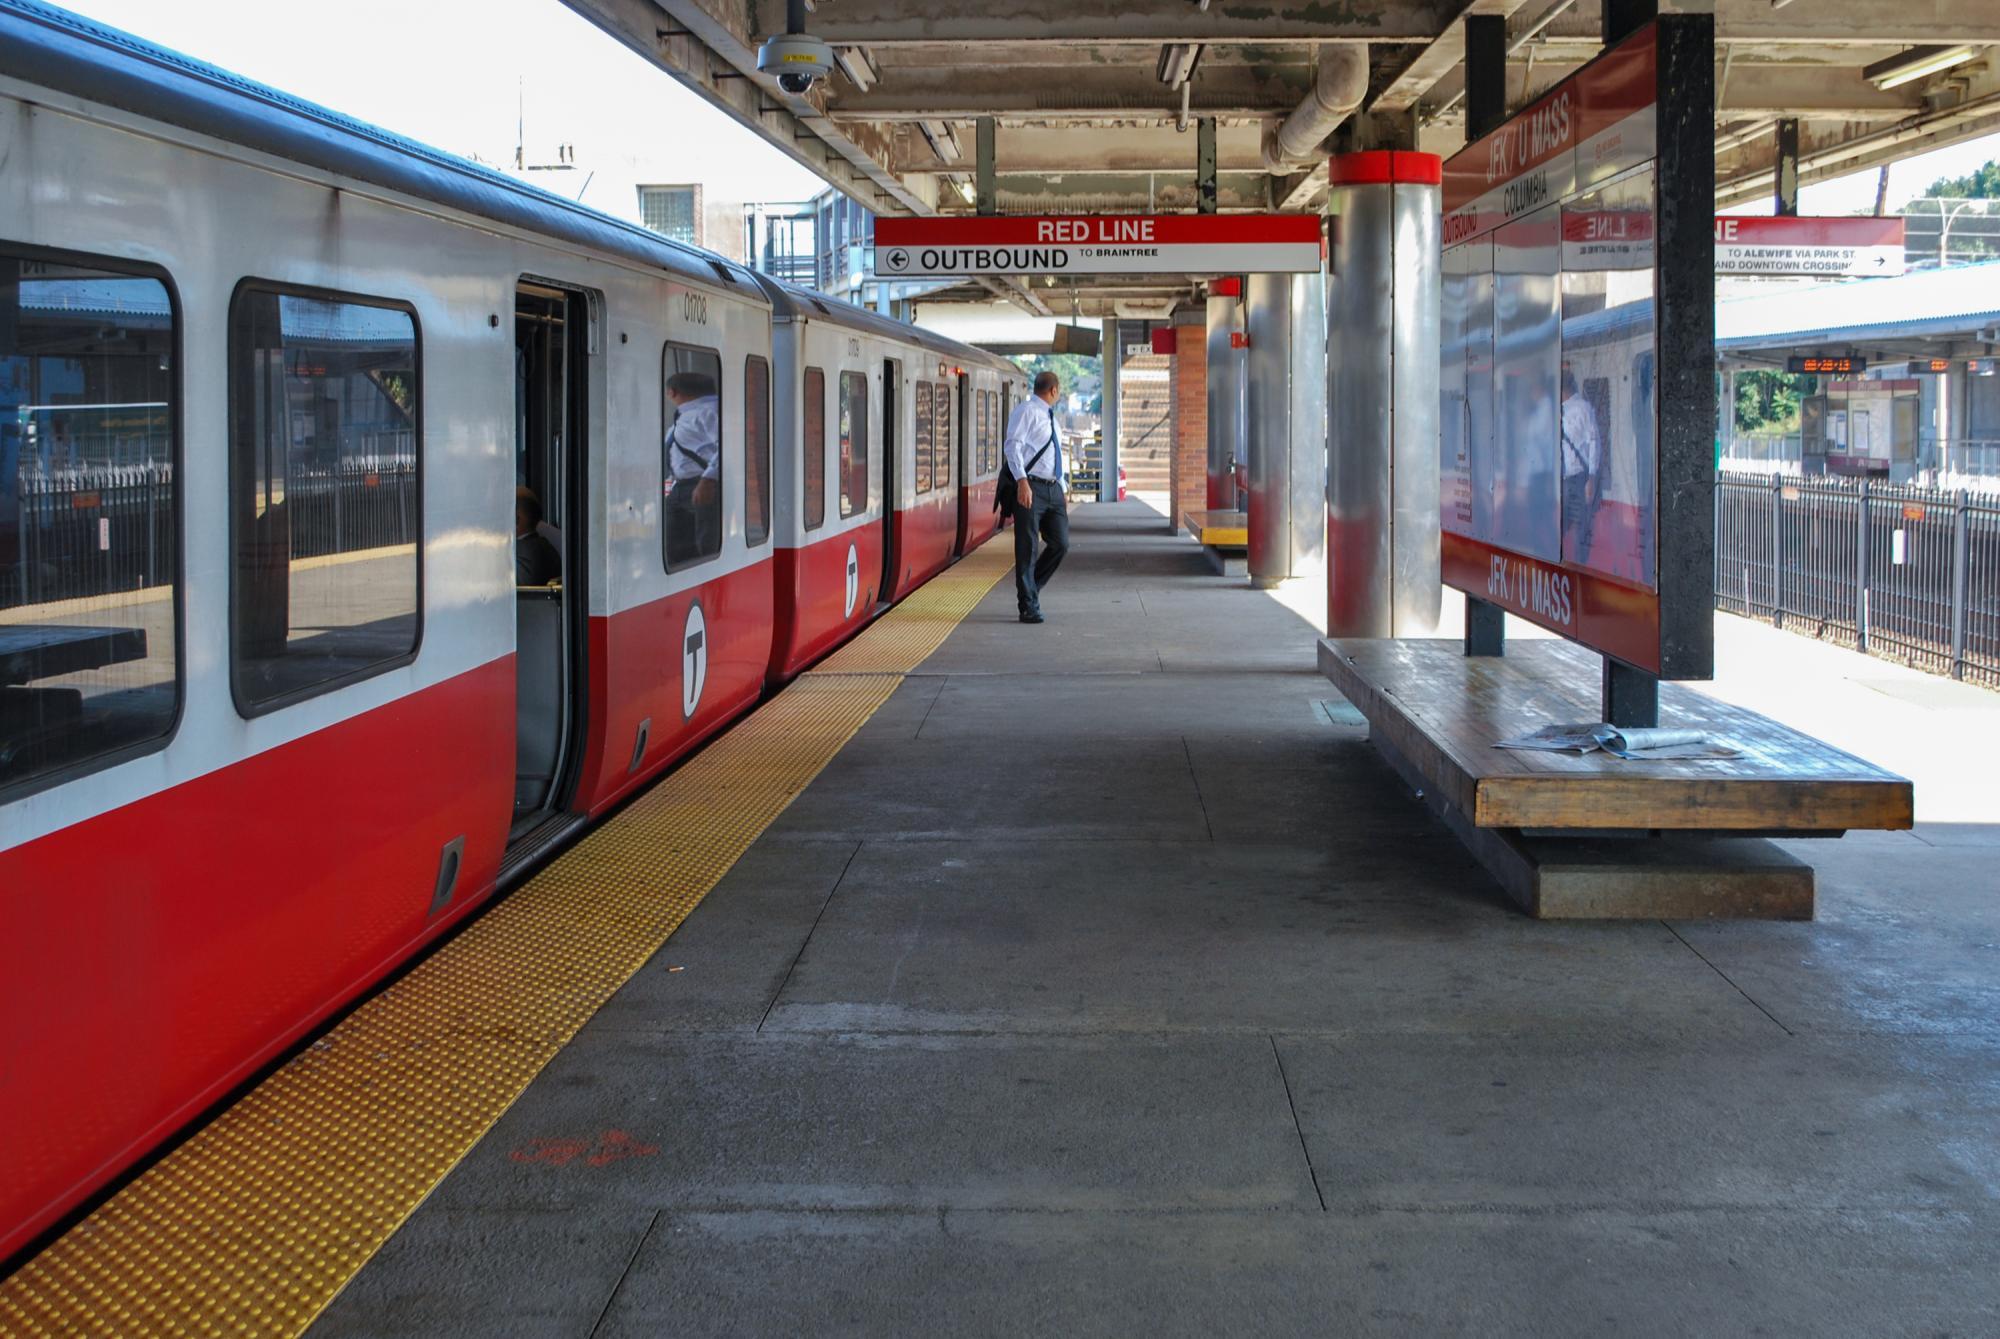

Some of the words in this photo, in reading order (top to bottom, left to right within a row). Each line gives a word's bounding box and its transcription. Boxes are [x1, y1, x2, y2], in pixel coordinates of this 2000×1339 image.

[1486, 131, 1508, 184] JFK
[1532, 91, 1570, 160] MASS
[1503, 170, 1548, 217] COLUMBIA
[1038, 220, 1090, 242] RED
[1099, 219, 1155, 241] LINE
[1443, 206, 1477, 244] OUTBOUND
[921, 249, 1069, 270] OUTBOUND
[1080, 248, 1093, 257] TO
[1096, 248, 1159, 257] BRAINTREE
[1715, 260, 1736, 270] AND
[1738, 260, 1800, 270] DOWNTOWN
[1803, 260, 1851, 271] CROSSIN
[1728, 249, 1742, 258] TO
[1744, 249, 1793, 258] ALEWIFE
[1795, 249, 1812, 258] VIA
[1814, 249, 1840, 259] PARK
[684, 291, 707, 325] 01708
[1487, 553, 1509, 601] JFK
[1532, 567, 1571, 625] MASS
